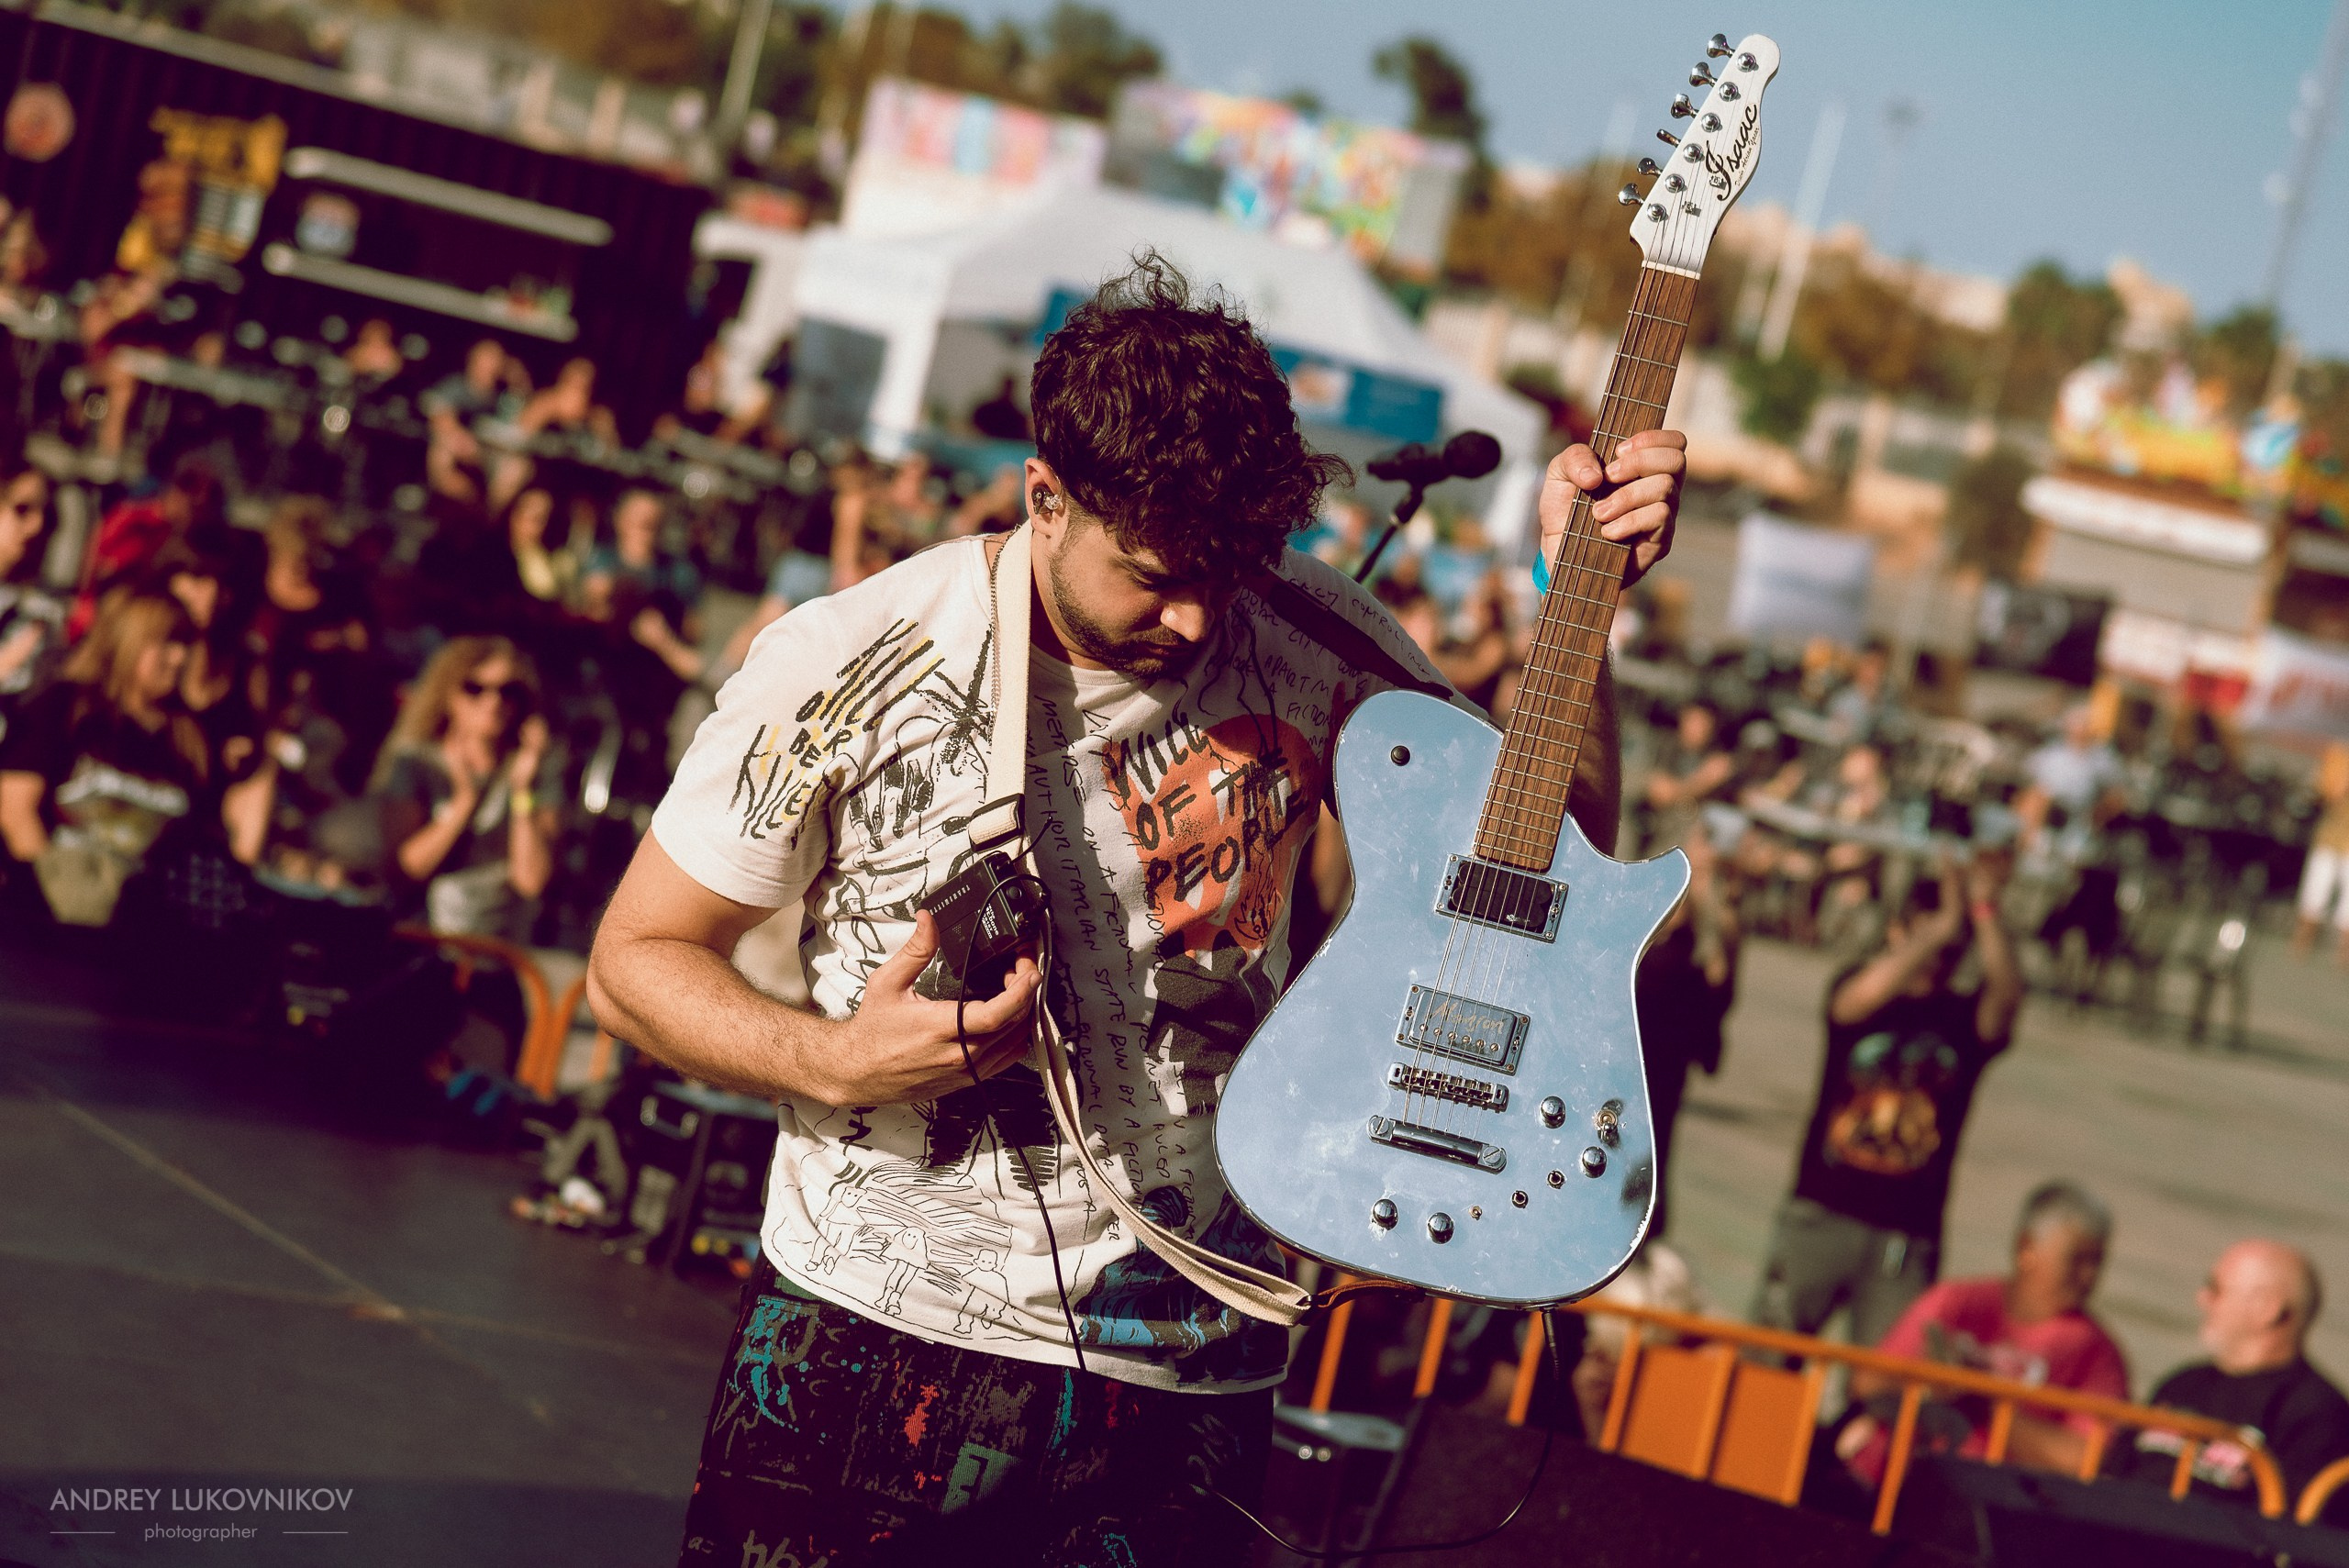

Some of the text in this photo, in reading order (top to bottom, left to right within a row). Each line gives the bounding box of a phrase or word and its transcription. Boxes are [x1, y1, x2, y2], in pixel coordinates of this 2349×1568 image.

[1705, 104, 1757, 201] Isaac
[1103, 711, 1211, 811] WILL
[1135, 780, 1197, 851] OF
[1082, 827, 1101, 851] ON
[1098, 865, 1118, 884] A
[1152, 1122, 1171, 1179] RULED
[1094, 968, 1127, 1023] STATE
[1107, 1032, 1130, 1072] RUN
[1118, 1084, 1137, 1108] BY
[1123, 1118, 1141, 1129] A
